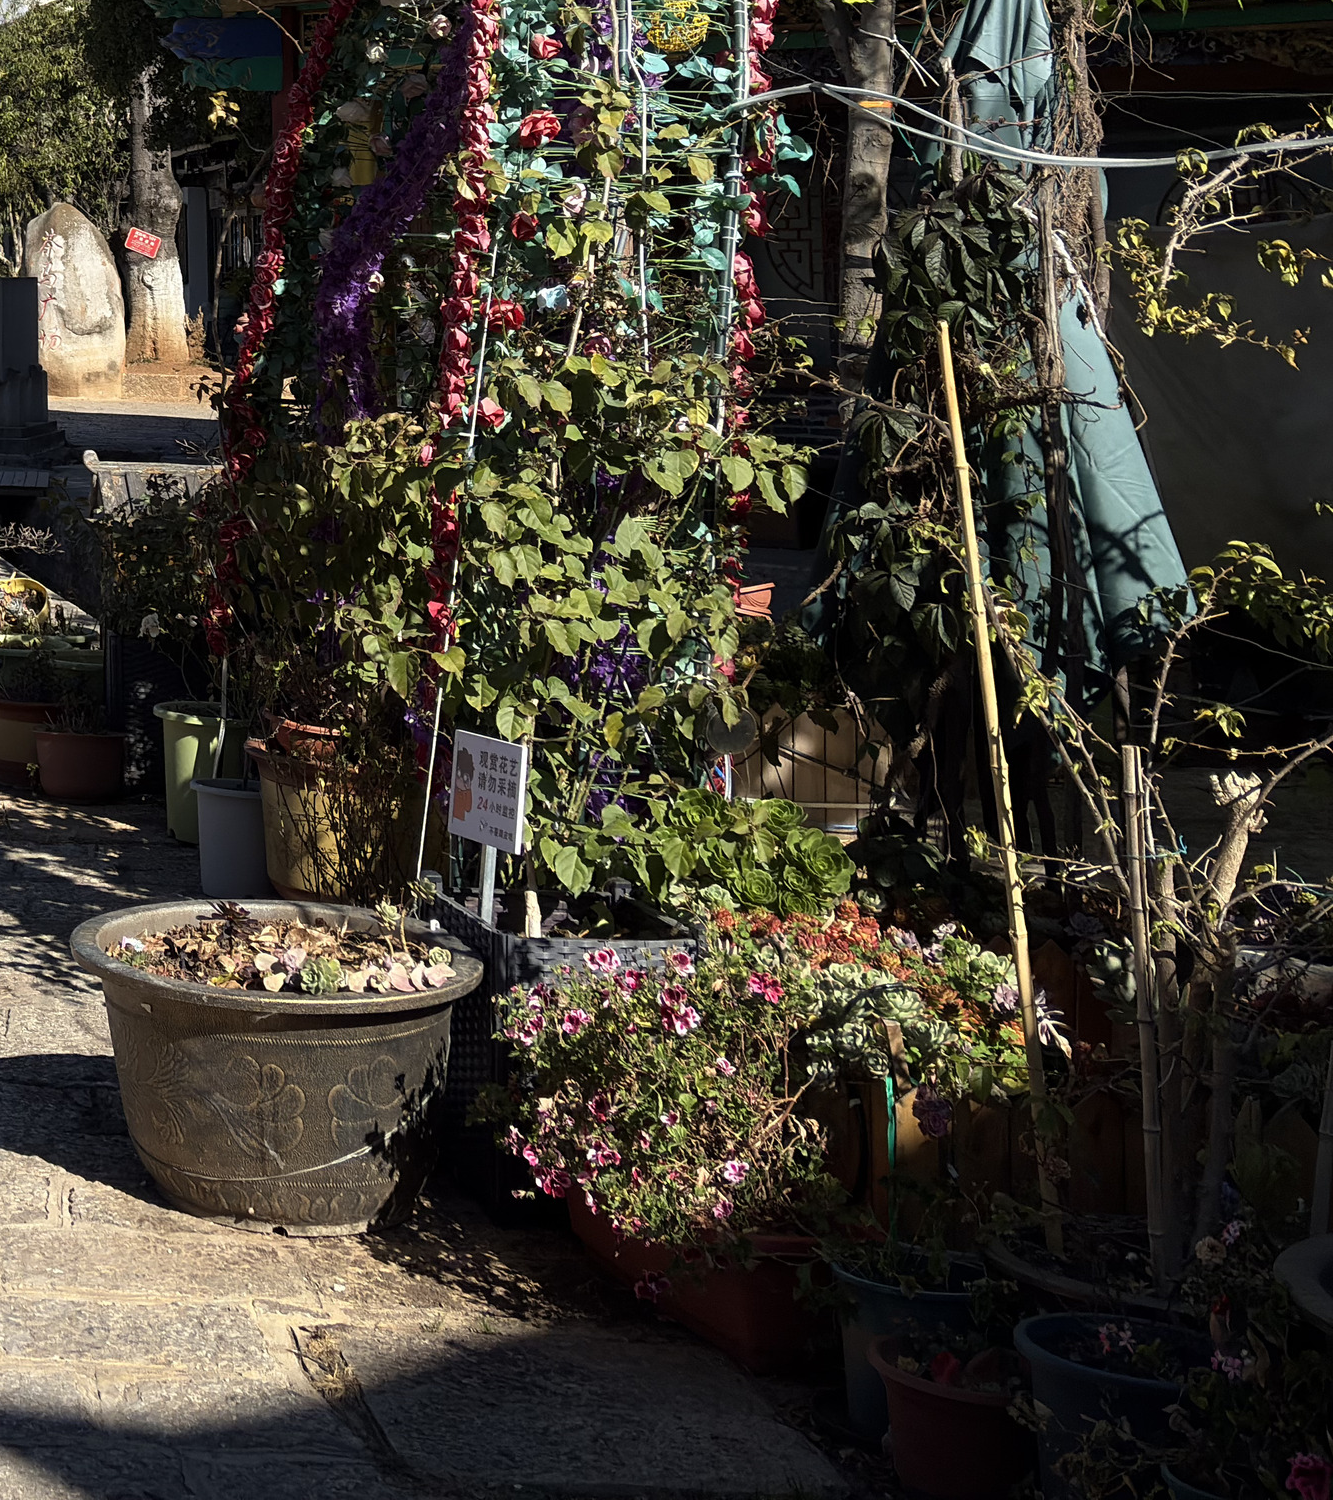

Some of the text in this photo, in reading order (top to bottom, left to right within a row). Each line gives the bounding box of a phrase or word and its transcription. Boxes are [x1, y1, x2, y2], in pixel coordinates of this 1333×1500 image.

[478, 750, 519, 777] 观赏花艺
[478, 771, 517, 799] 请勿采摘
[477, 796, 515, 820] 24 小时监控
